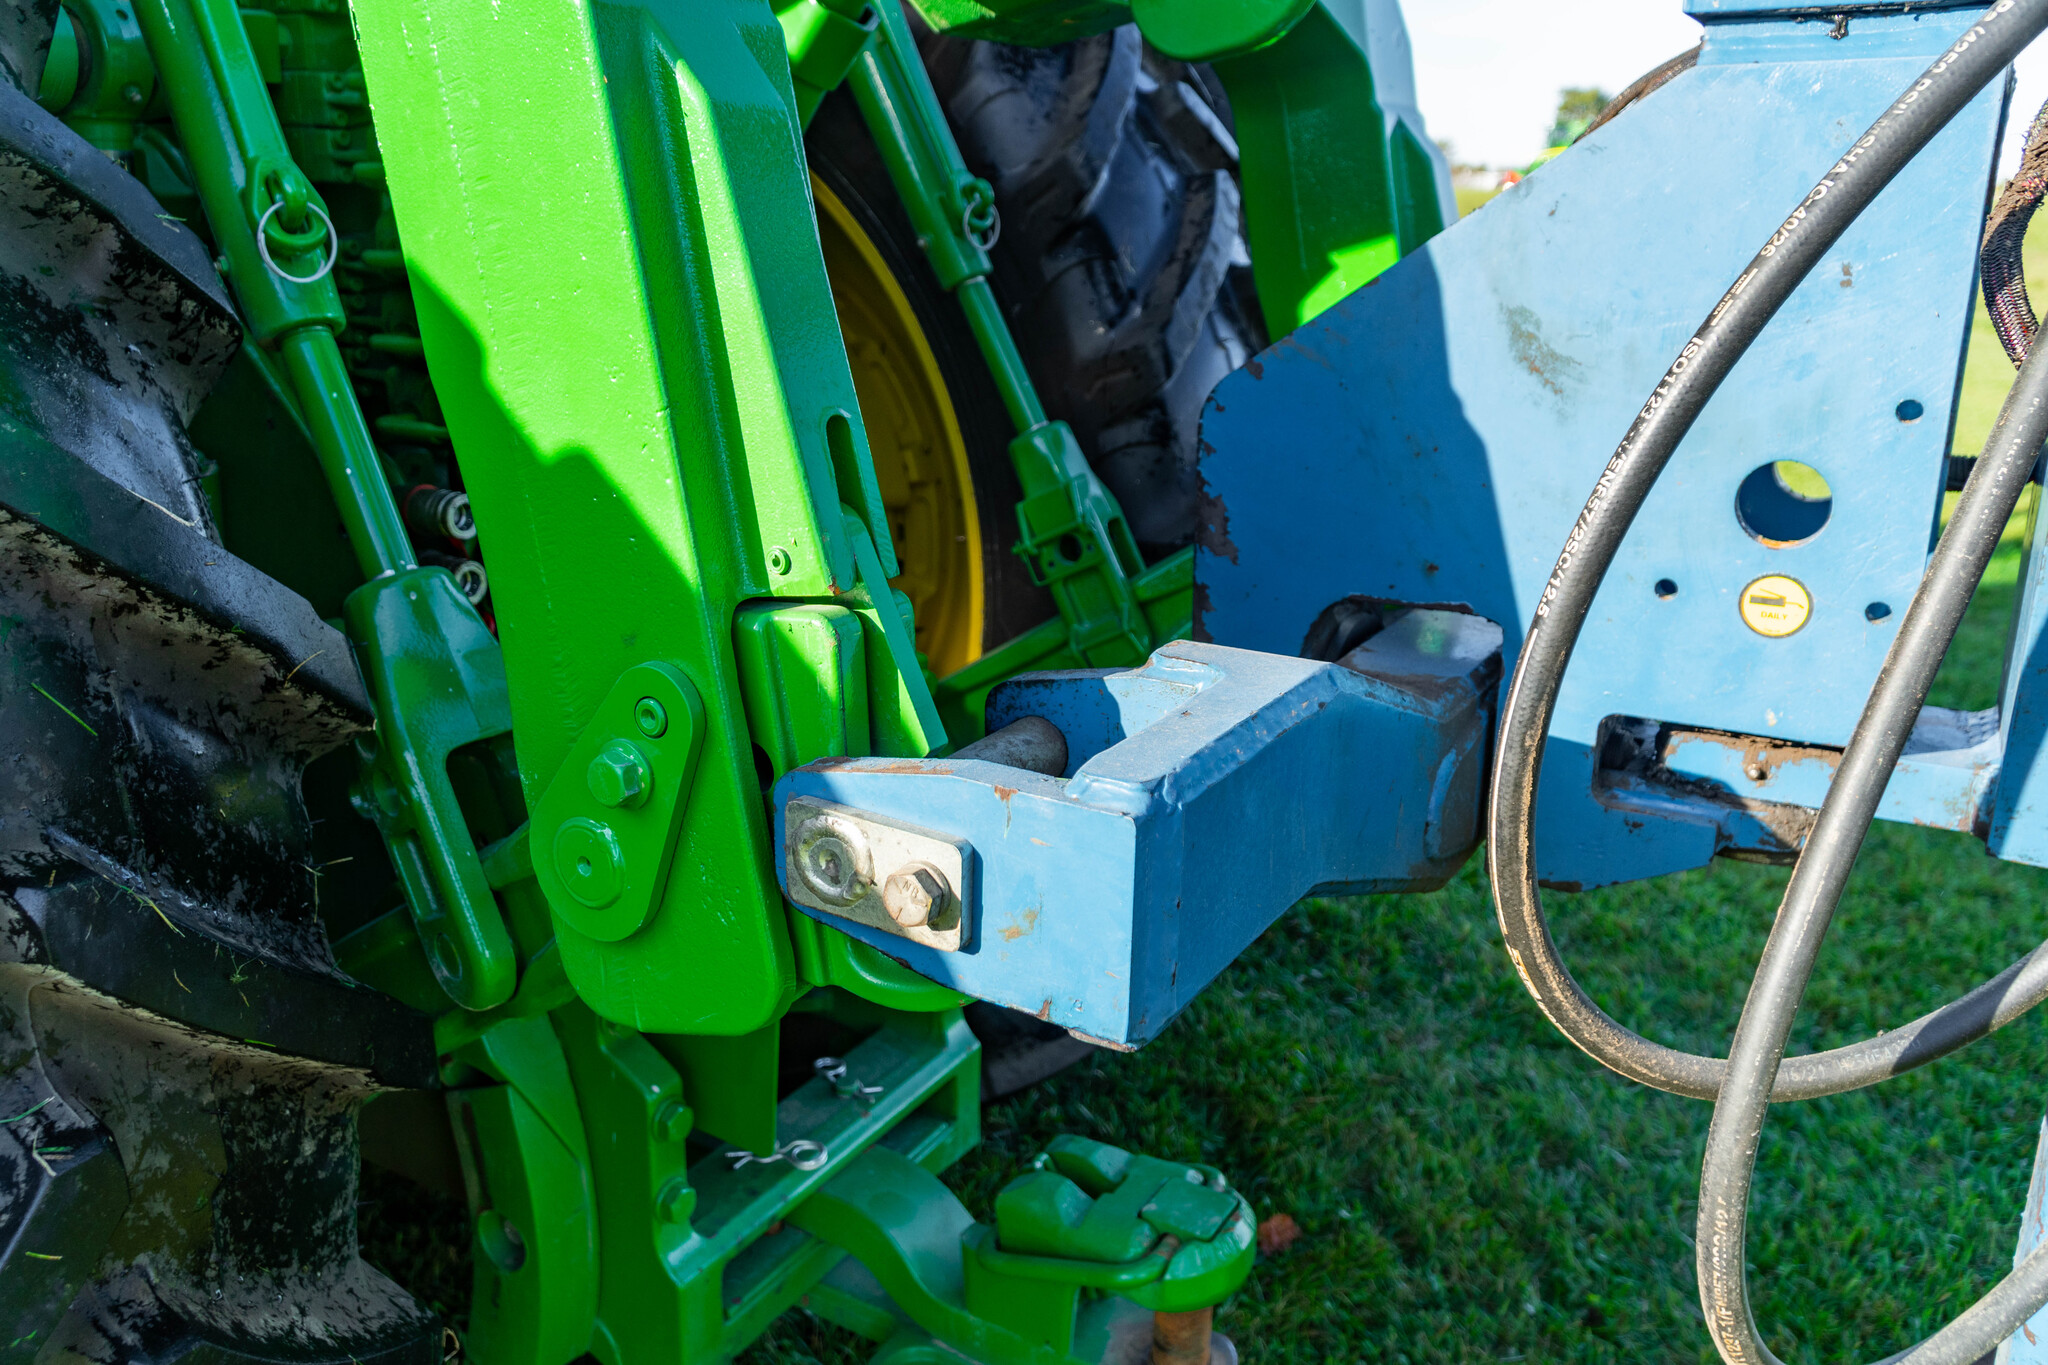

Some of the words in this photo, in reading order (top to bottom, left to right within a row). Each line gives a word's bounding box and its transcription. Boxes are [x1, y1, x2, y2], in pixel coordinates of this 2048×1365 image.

[1760, 178, 1834, 257] IC-40/26
[1713, 302, 1725, 315] USA
[1761, 611, 1788, 620] DAILY
